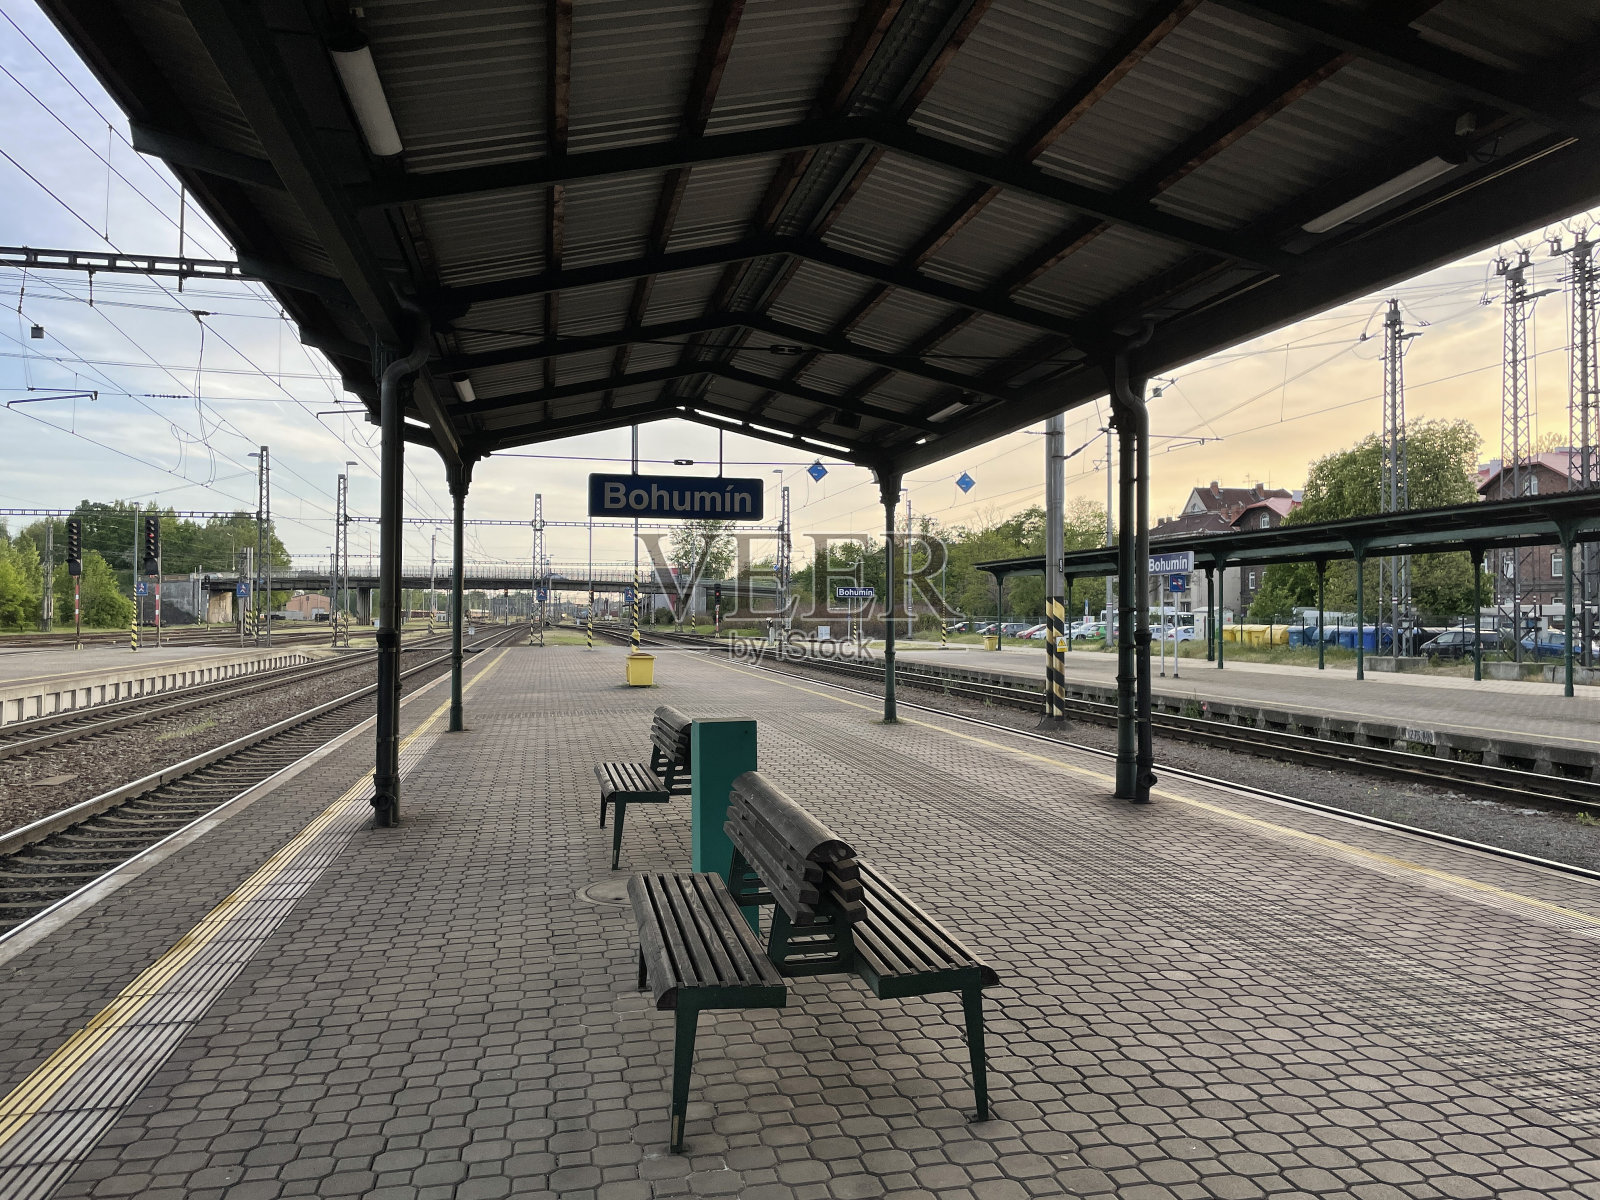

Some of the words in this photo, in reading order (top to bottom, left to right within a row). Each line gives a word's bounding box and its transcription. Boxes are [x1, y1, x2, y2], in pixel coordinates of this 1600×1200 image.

[604, 481, 752, 513] Bohumín
[1149, 556, 1188, 572] Bohumín
[838, 588, 873, 596] Bohumín
